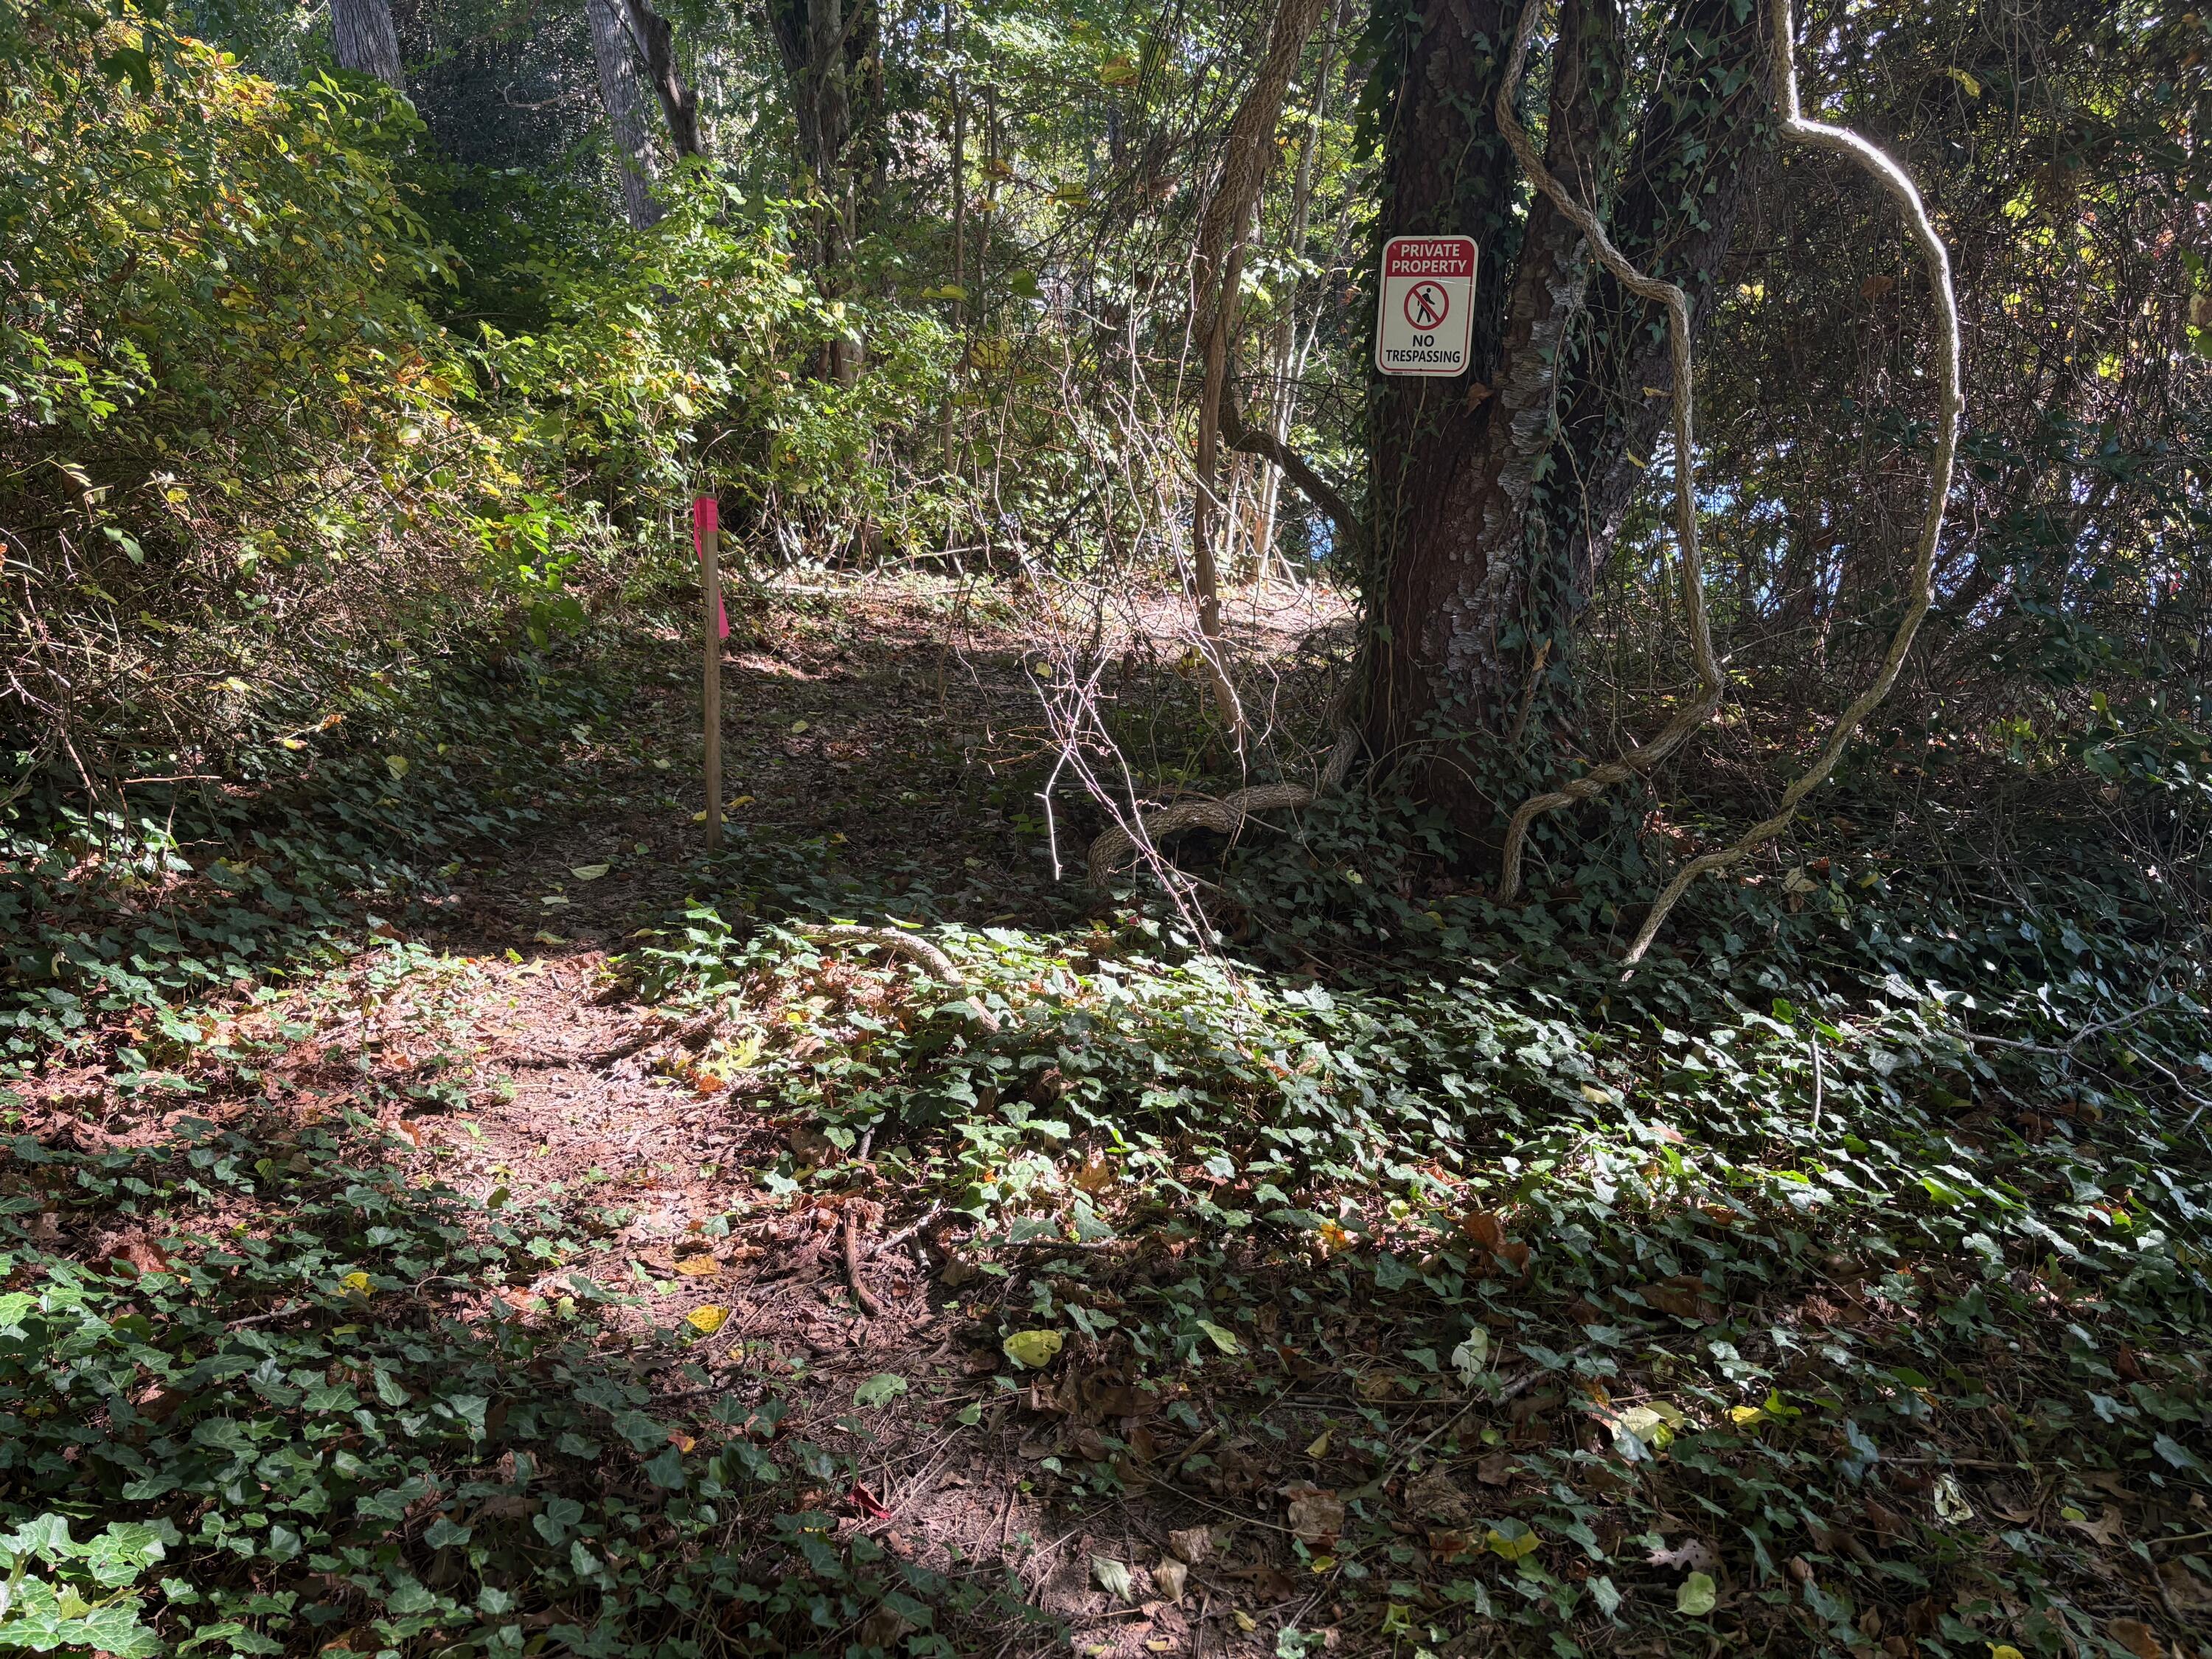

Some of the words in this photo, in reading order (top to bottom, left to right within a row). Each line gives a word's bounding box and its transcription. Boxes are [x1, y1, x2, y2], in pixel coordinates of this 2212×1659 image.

[1401, 244, 1460, 257] PRIVATE
[1391, 260, 1467, 273] PROPERTY
[1412, 335, 1434, 347] NO
[1385, 349, 1460, 363] TRESPASSING
